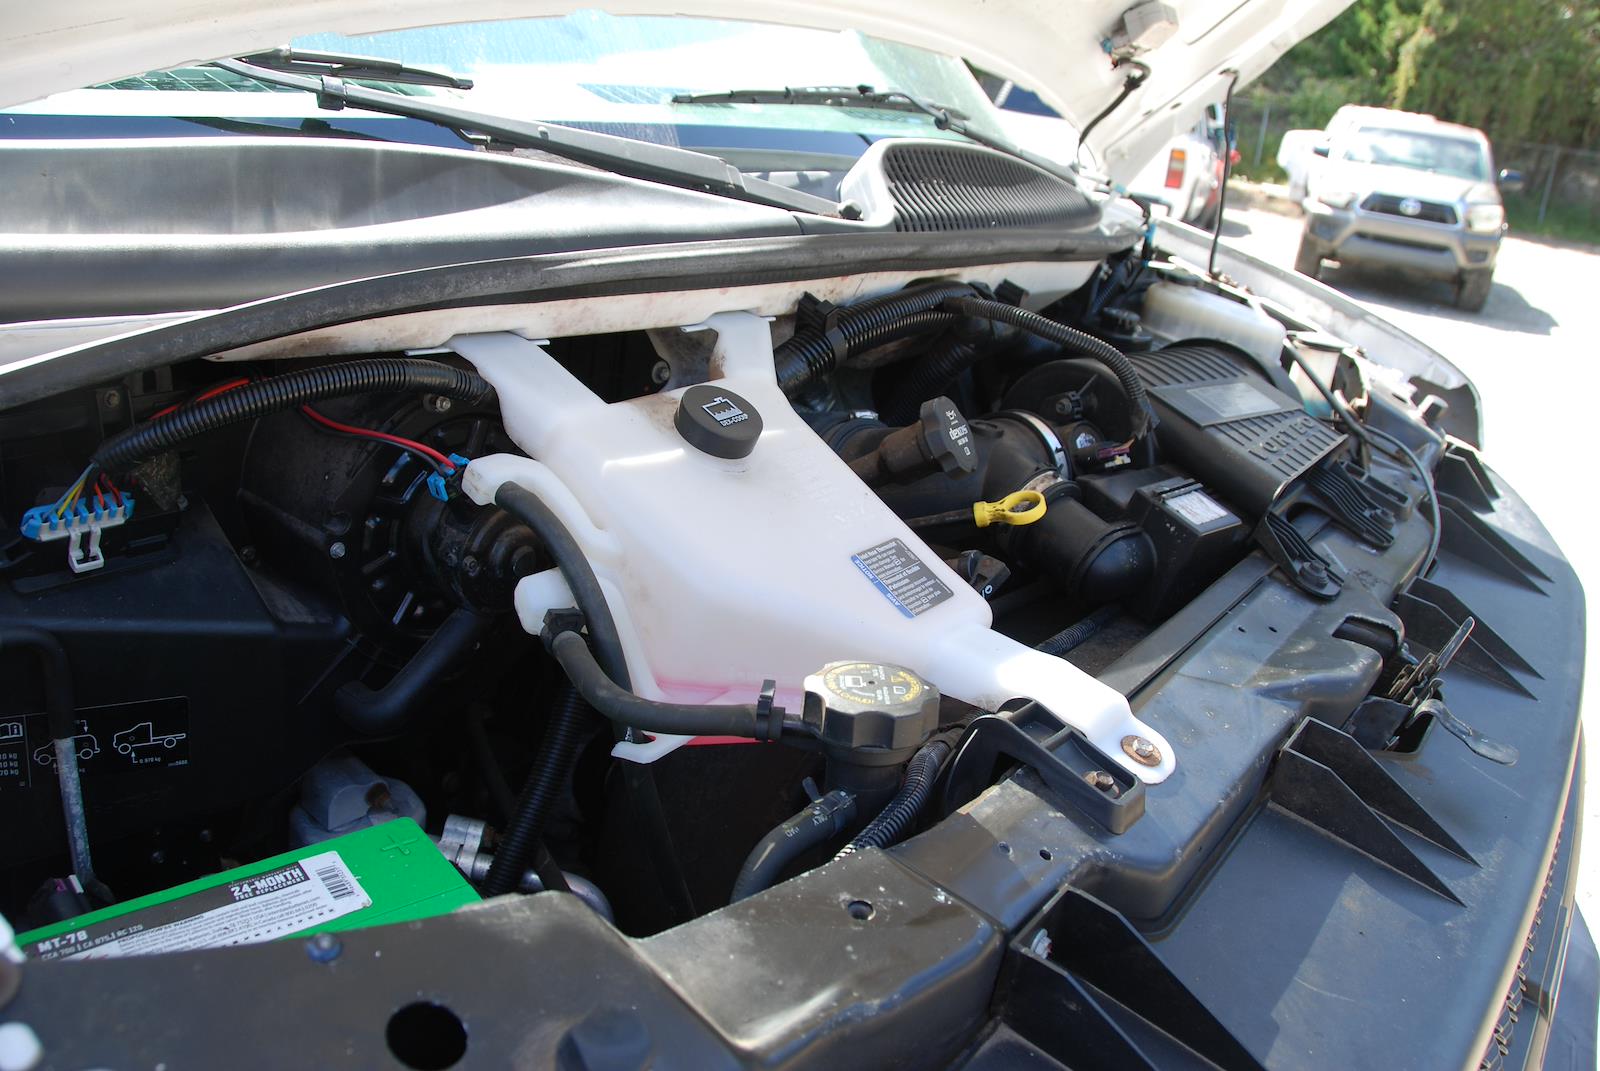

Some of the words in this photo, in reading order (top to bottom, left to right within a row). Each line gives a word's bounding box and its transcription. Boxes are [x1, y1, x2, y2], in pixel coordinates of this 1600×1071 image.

[231, 866, 304, 897] 24-MONTH
[235, 891, 253, 900] FREE
[254, 876, 307, 896] REPLACEMENT
[37, 930, 89, 953] MT-78
